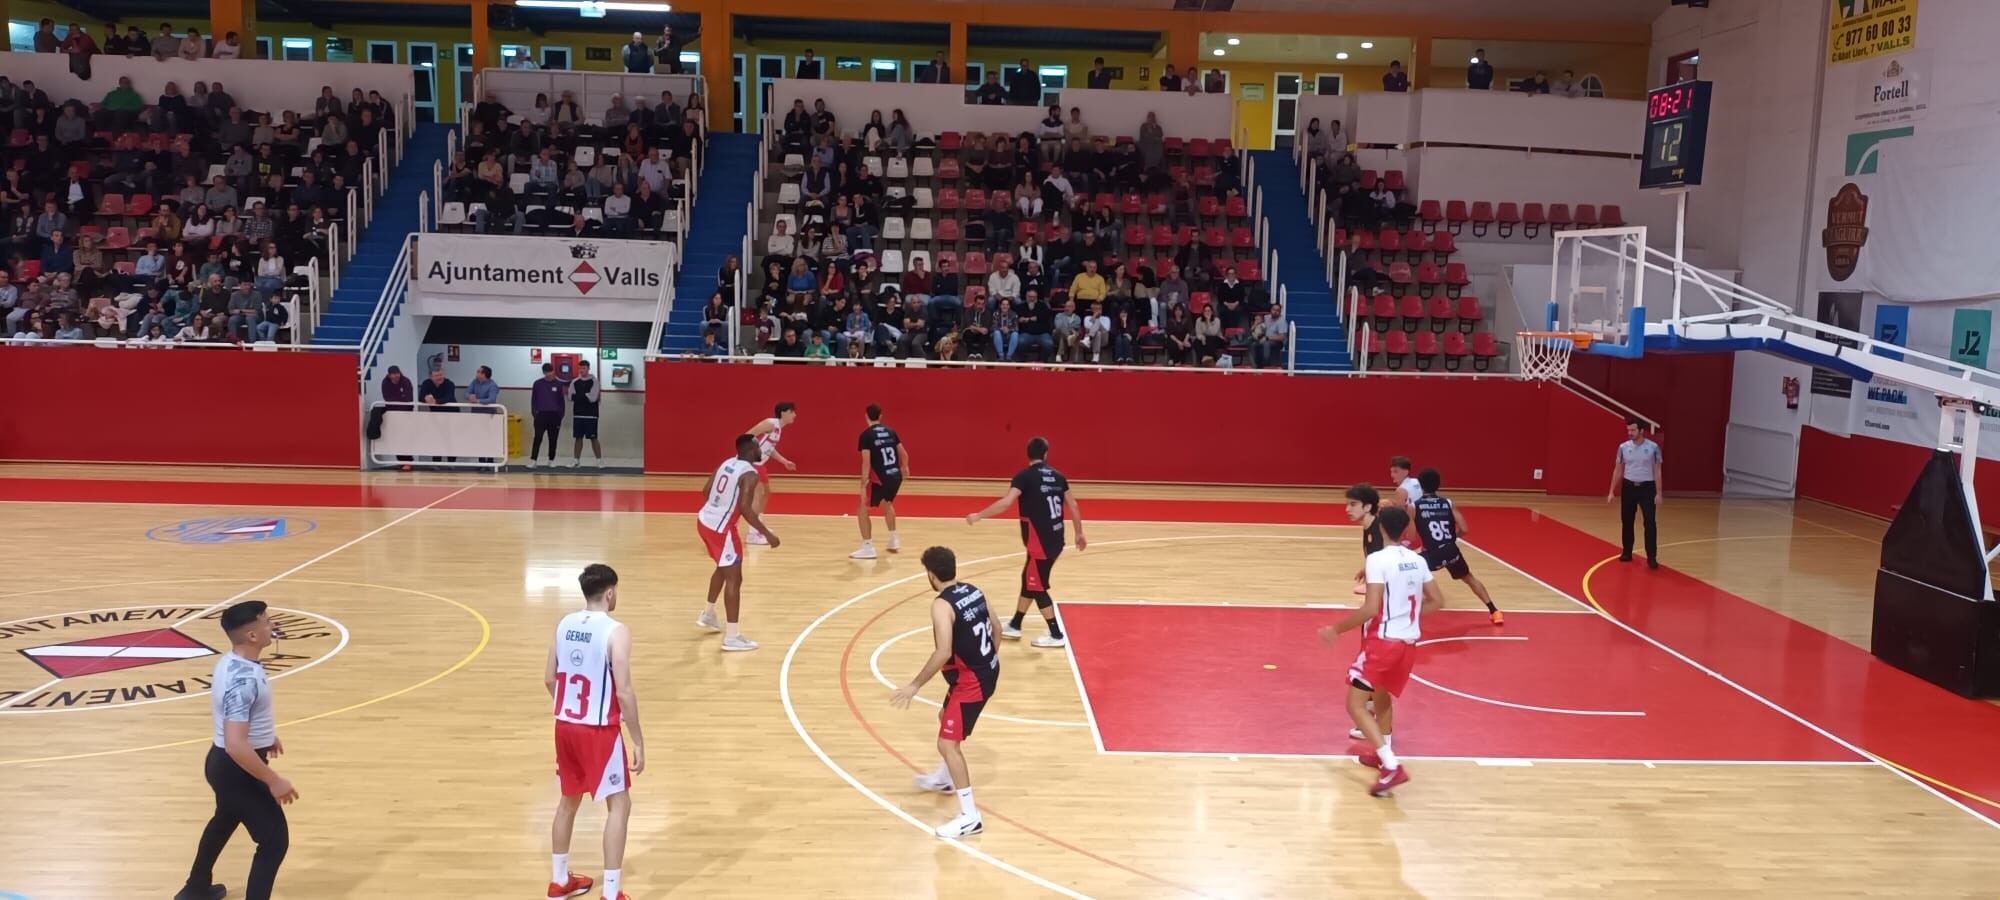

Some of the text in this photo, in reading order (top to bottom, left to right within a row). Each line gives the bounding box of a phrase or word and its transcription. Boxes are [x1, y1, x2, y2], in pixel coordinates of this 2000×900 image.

[1845, 27, 1863, 46] 977
[1866, 23, 1878, 41] 60
[1881, 19, 1895, 37] 80
[1898, 15, 1912, 33] 33
[1877, 36, 1910, 51] VALLS
[1650, 87, 1693, 118] 08:21
[1661, 122, 1683, 161] 12
[428, 261, 660, 286] Ajuntament Valls
[881, 447, 896, 466] 13
[716, 474, 729, 494] 0
[1046, 495, 1062, 519] 16
[1428, 520, 1452, 541] 85
[1407, 594, 1416, 624] 1
[565, 629, 593, 644] GERARD
[554, 671, 591, 721] 13
